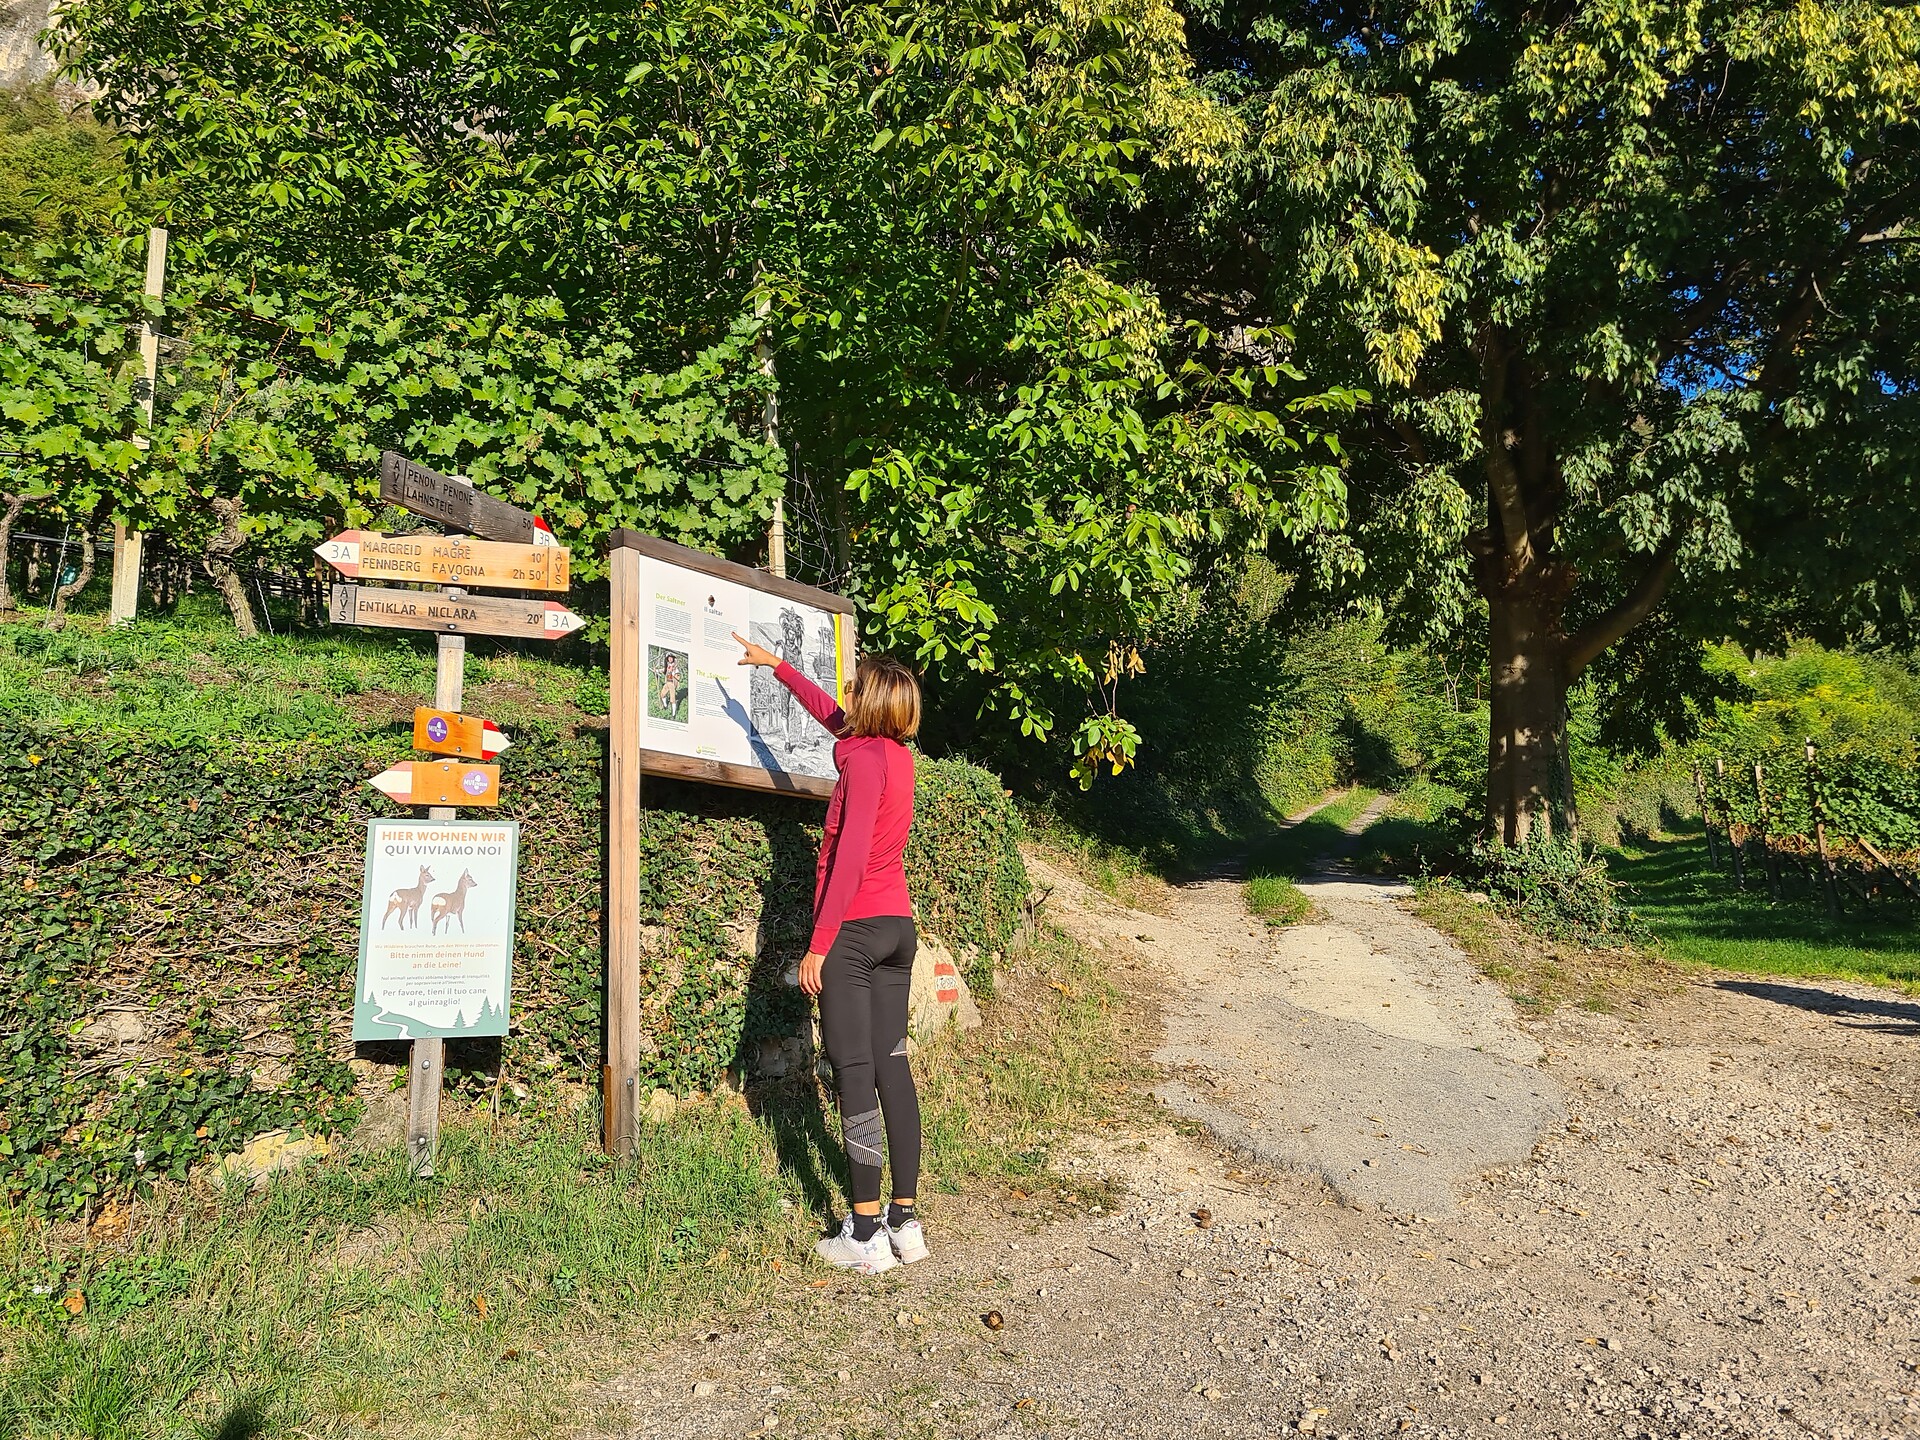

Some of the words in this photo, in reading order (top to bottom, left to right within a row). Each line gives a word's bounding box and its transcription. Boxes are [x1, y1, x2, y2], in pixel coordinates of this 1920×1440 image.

[392, 460, 400, 494] AVS
[408, 469, 436, 490] PENON
[443, 484, 474, 506] PENONE
[406, 487, 454, 514] LAHNSTEIG
[331, 544, 350, 560] 3A
[363, 541, 422, 556] MARGREID
[433, 546, 471, 560] MAGRÈ
[532, 553, 544, 564] 10'
[362, 558, 421, 572] FENNBERG
[432, 563, 485, 576] FAVOGNA
[513, 568, 525, 580] 2h
[529, 570, 544, 580] 50'
[339, 586, 348, 620] AVS
[359, 601, 416, 615] ENTIKLAR
[428, 606, 477, 620] NICLARA
[527, 614, 542, 624] 20'
[552, 614, 570, 628] 3A
[382, 831, 413, 841] HIER
[418, 832, 478, 842] WOHNEN
[481, 832, 506, 842] WIR
[385, 845, 410, 856] QUI
[414, 846, 474, 856] VIVIAMO
[477, 846, 501, 856] NOI
[418, 998, 461, 1007] guinzaglio!
